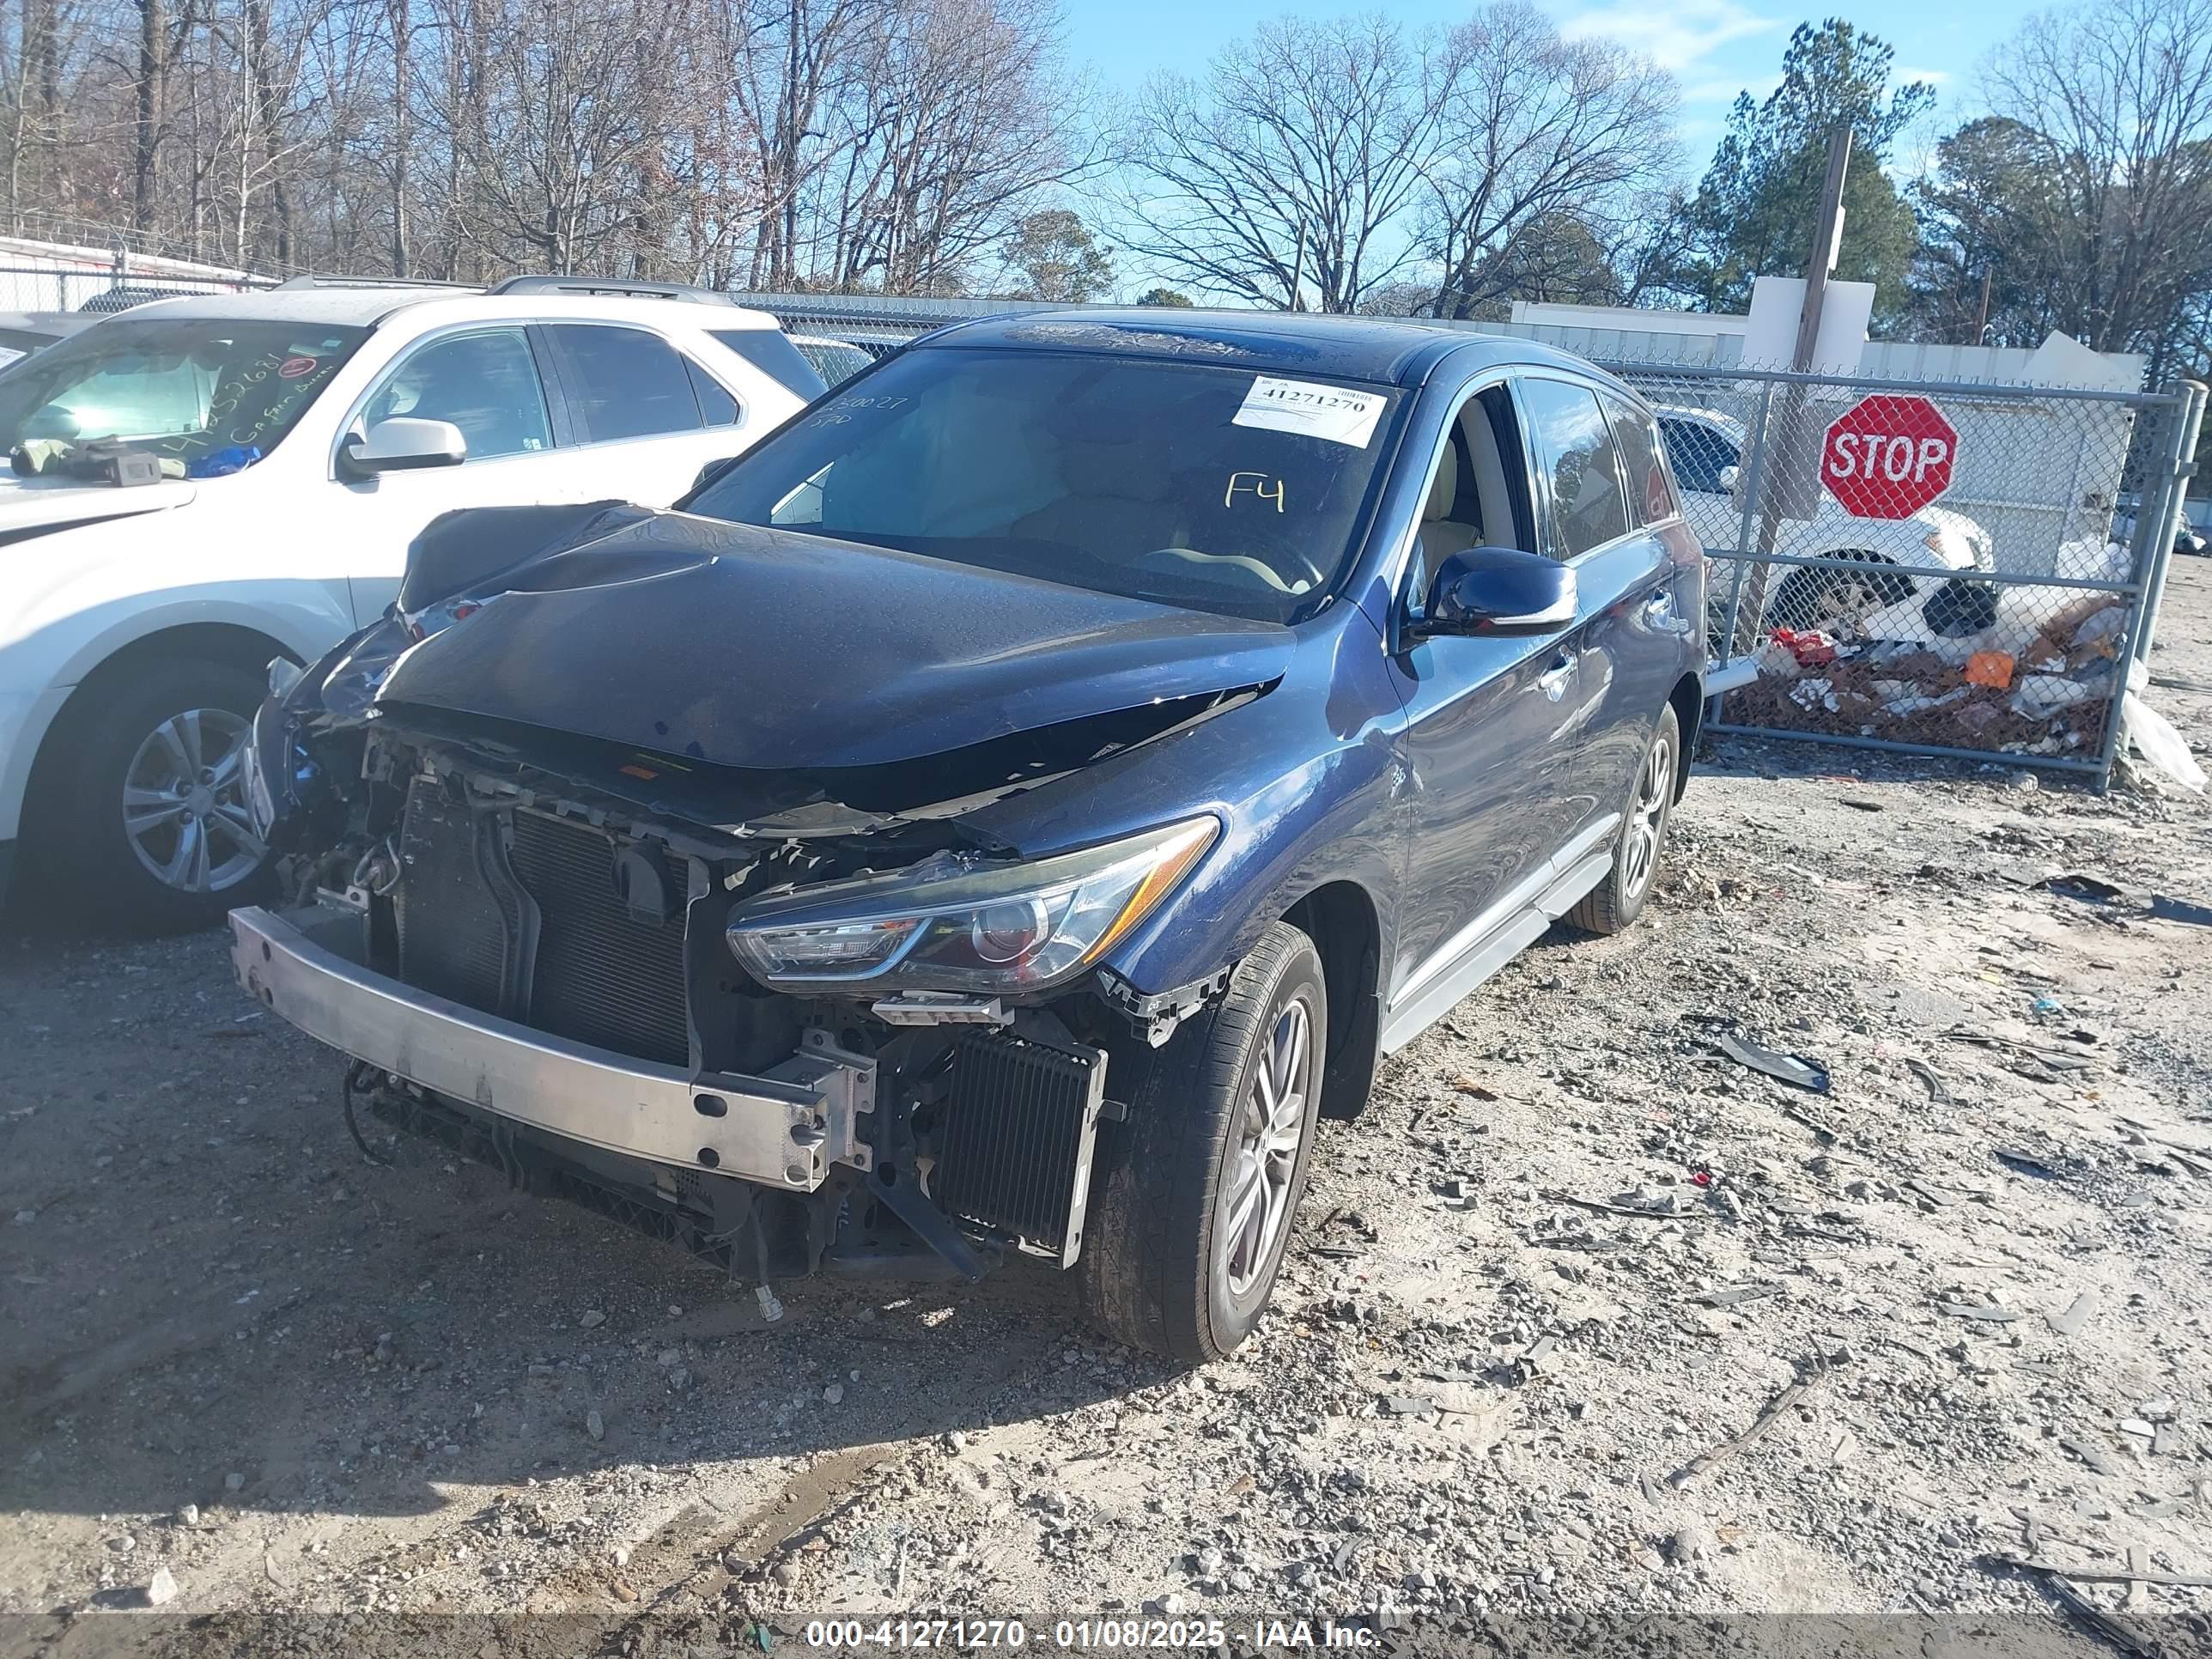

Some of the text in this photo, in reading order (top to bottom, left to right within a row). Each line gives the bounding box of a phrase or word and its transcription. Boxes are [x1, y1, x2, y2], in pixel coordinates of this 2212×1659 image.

[1263, 389, 1365, 413] 41271270
[1830, 432, 1948, 483] STOP
[1224, 471, 1285, 514] F4
